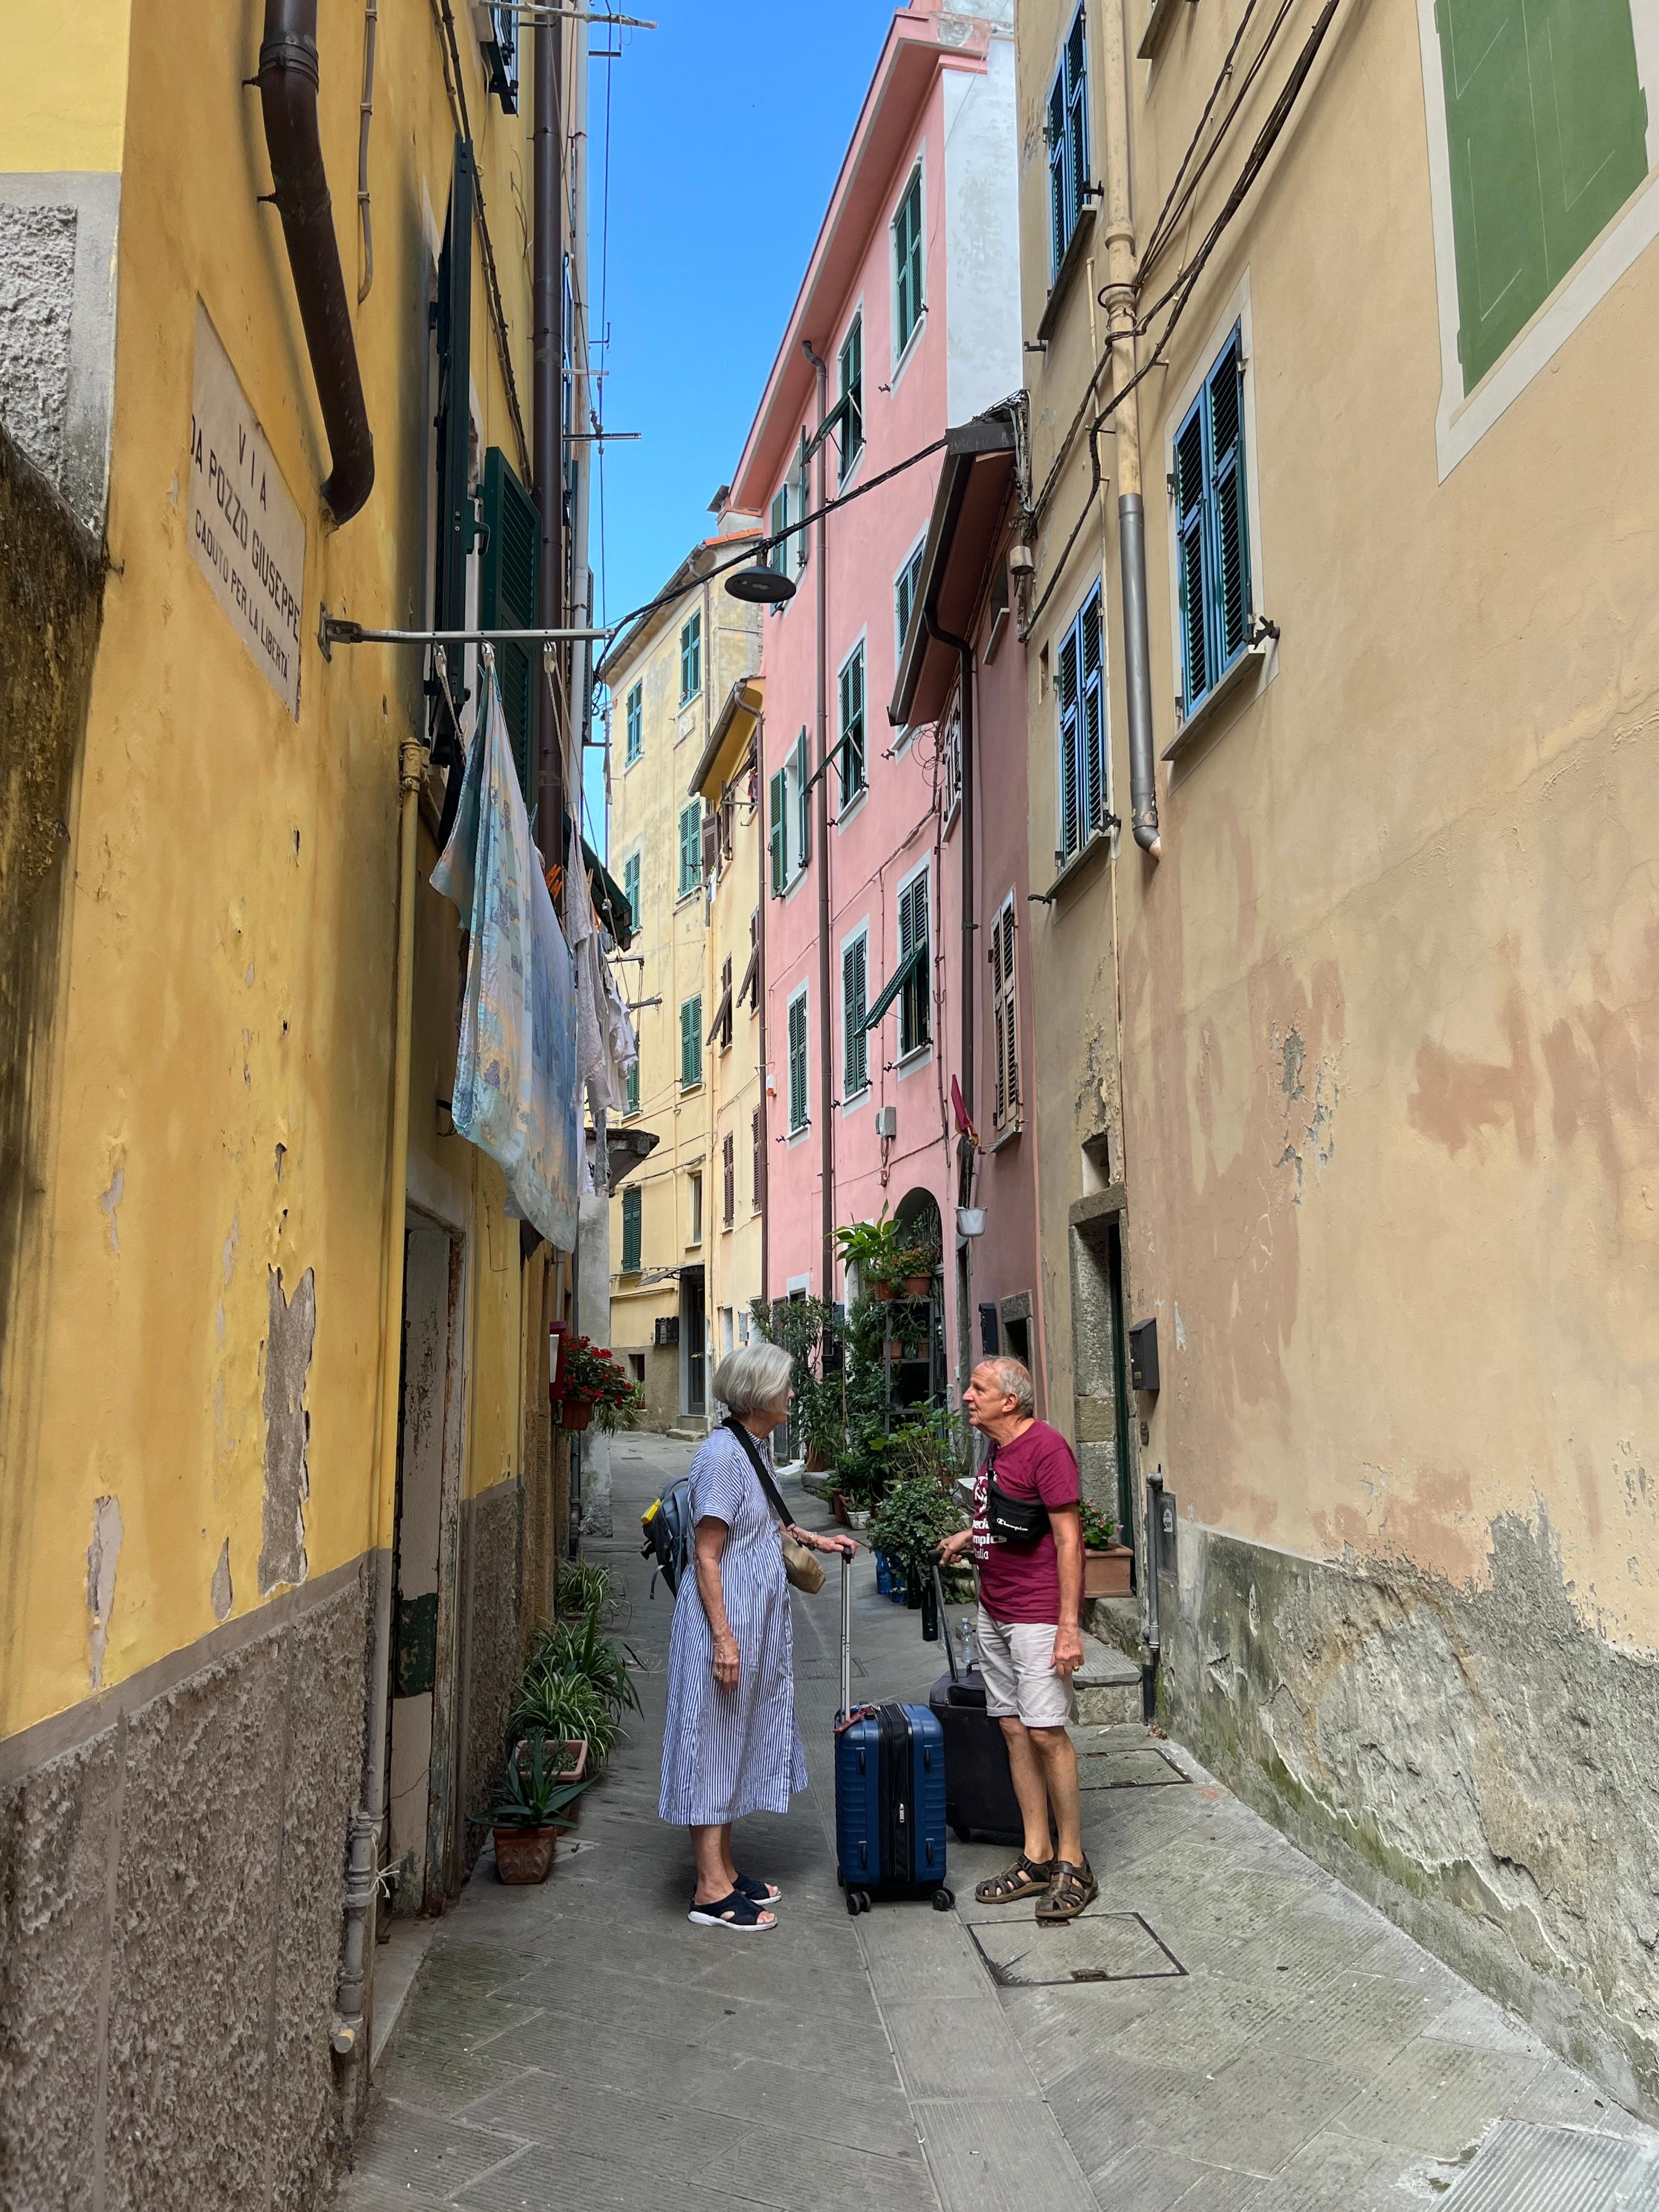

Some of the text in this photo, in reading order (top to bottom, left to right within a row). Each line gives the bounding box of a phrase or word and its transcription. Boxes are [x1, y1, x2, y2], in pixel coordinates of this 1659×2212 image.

[238, 422, 267, 512] VIA
[195, 508, 229, 583] CADUTO
[230, 568, 247, 616] PER
[249, 599, 258, 635] LA
[208, 447, 248, 550] POZZO
[251, 529, 300, 644] GIUSEPPE
[996, 1517, 1029, 1531] Champion
